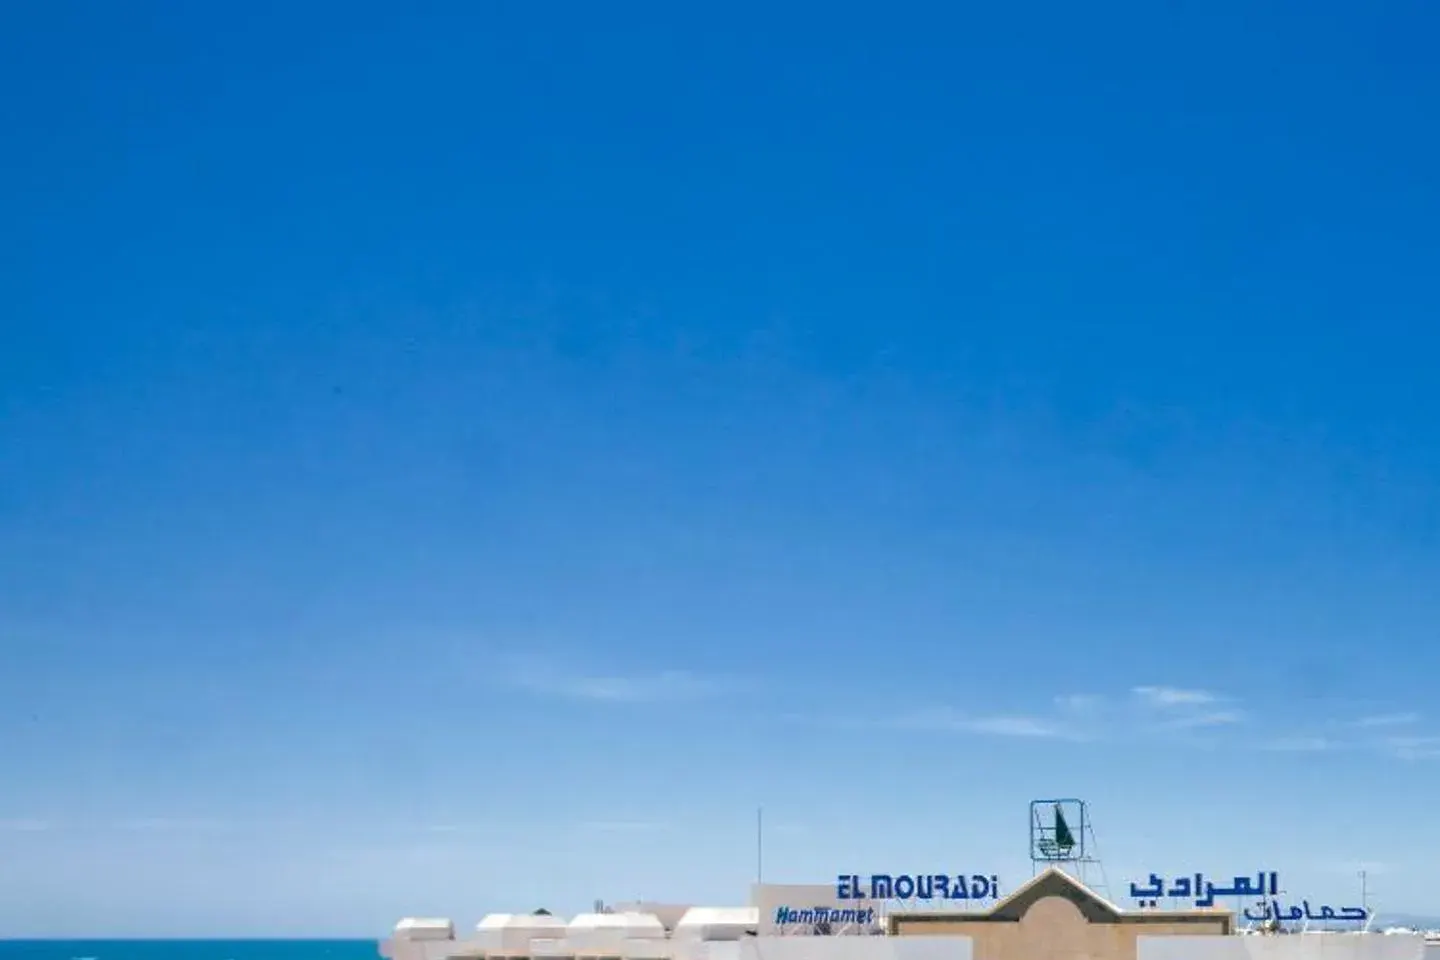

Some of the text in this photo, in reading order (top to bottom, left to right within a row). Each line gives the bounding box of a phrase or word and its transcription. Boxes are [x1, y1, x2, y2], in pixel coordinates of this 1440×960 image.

[837, 875, 866, 900] EL
[1130, 872, 1278, 907] المرادي
[775, 906, 874, 925] Hammamet
[1244, 900, 1368, 921] حمامات
